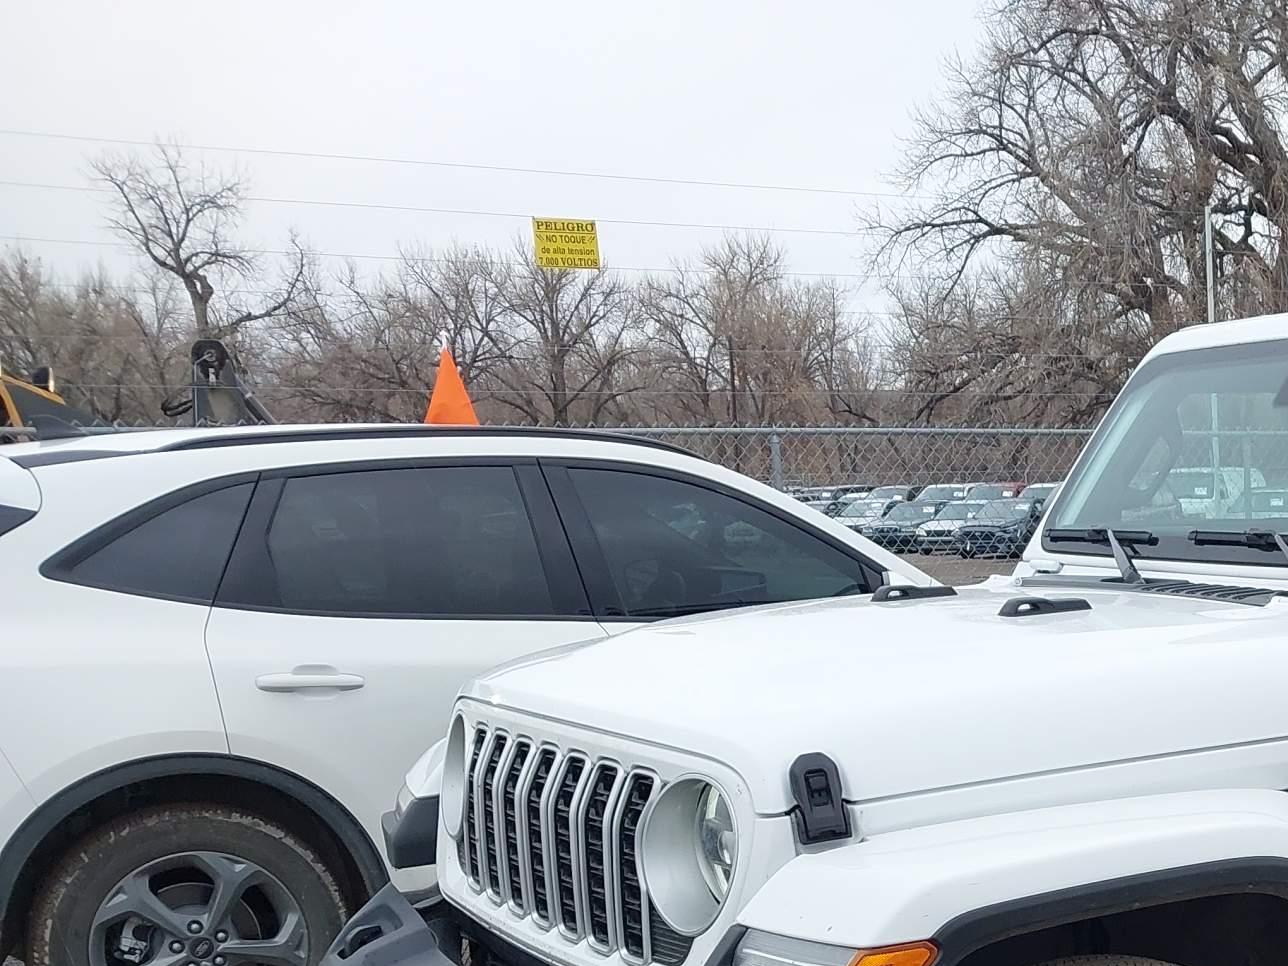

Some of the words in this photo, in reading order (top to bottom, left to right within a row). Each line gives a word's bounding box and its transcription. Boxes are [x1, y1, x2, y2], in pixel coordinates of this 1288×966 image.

[536, 220, 594, 233] PELIGRO
[546, 234, 557, 243] NO
[541, 246, 551, 254] de
[552, 247, 566, 255] alta
[568, 247, 595, 256] tension
[560, 258, 598, 267] VOLTIOS
